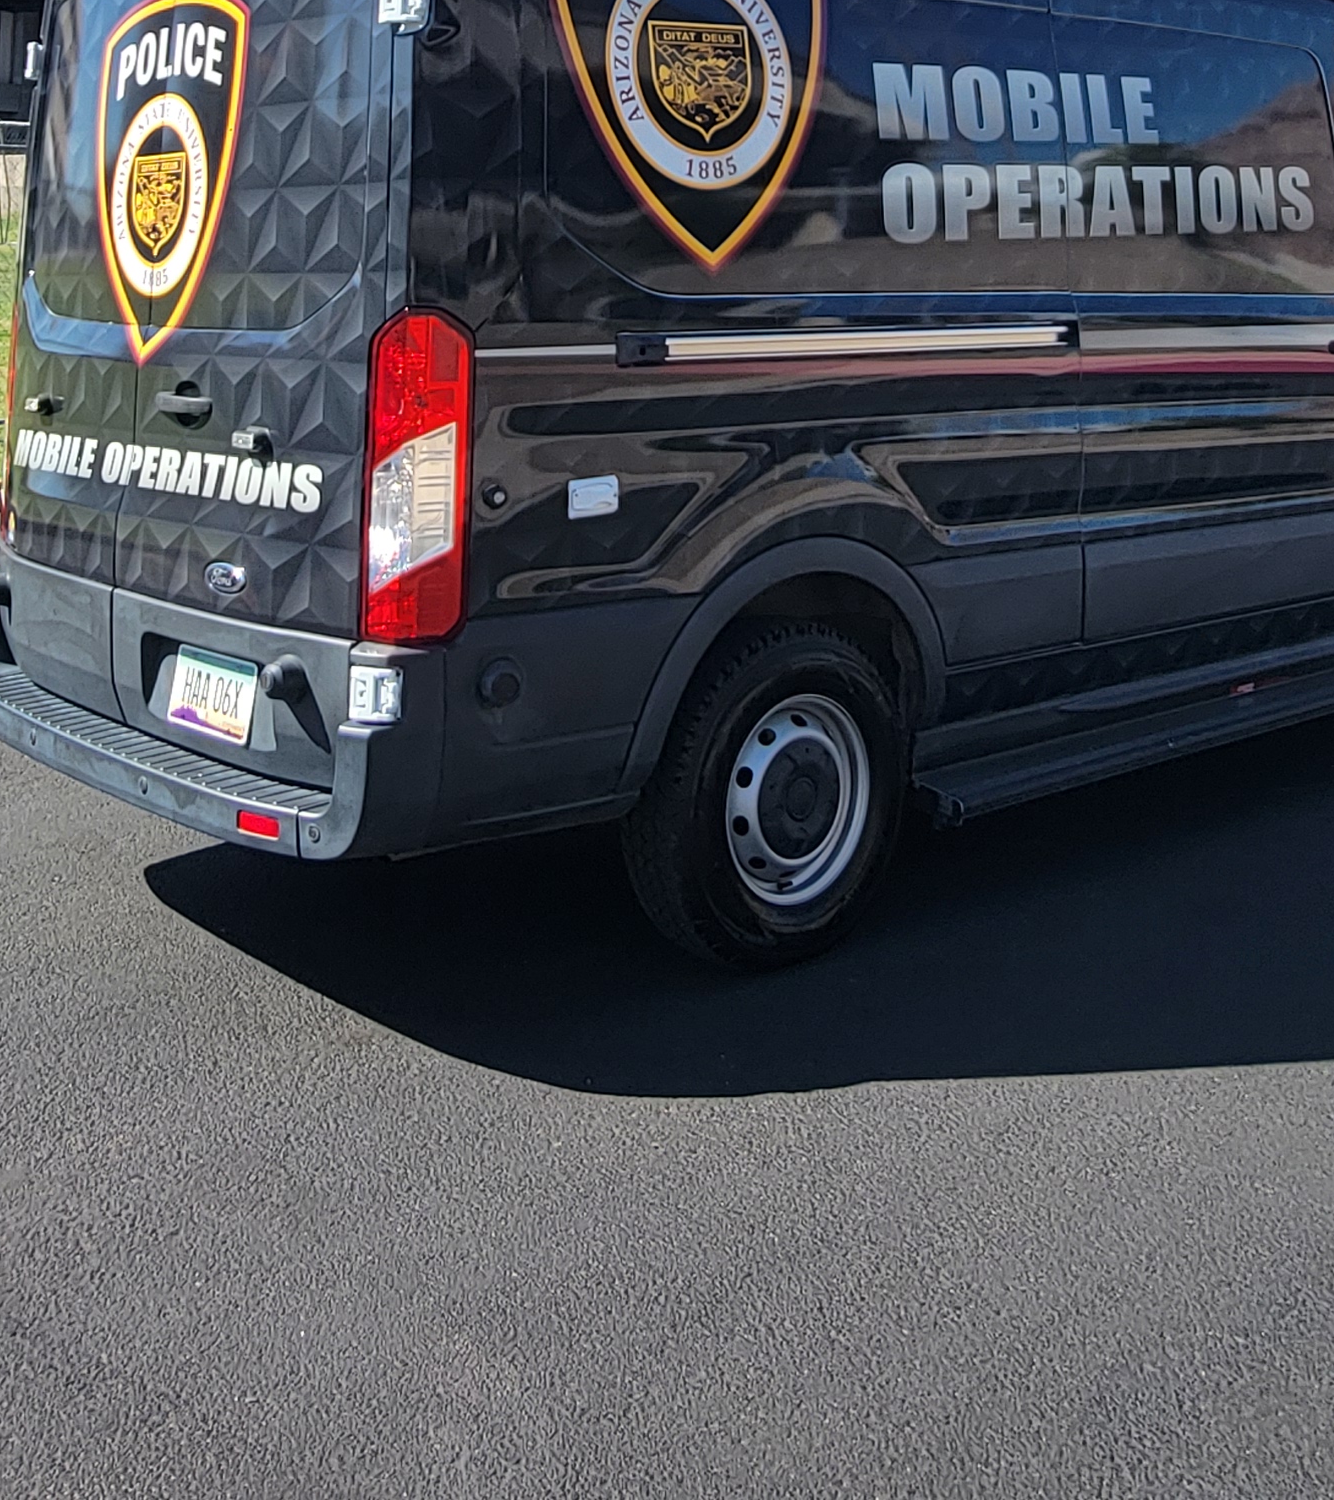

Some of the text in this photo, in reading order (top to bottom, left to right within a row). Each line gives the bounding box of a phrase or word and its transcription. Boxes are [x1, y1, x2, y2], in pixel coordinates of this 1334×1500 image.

[115, 21, 227, 102] POLICE
[662, 30, 736, 44] DITAT DEUS
[872, 61, 1160, 145] MOBILE
[685, 155, 738, 180] 1885
[881, 161, 1315, 245] OPERATIONS
[13, 429, 323, 513] MOBILE OPERATIONS
[181, 666, 211, 710] HAA
